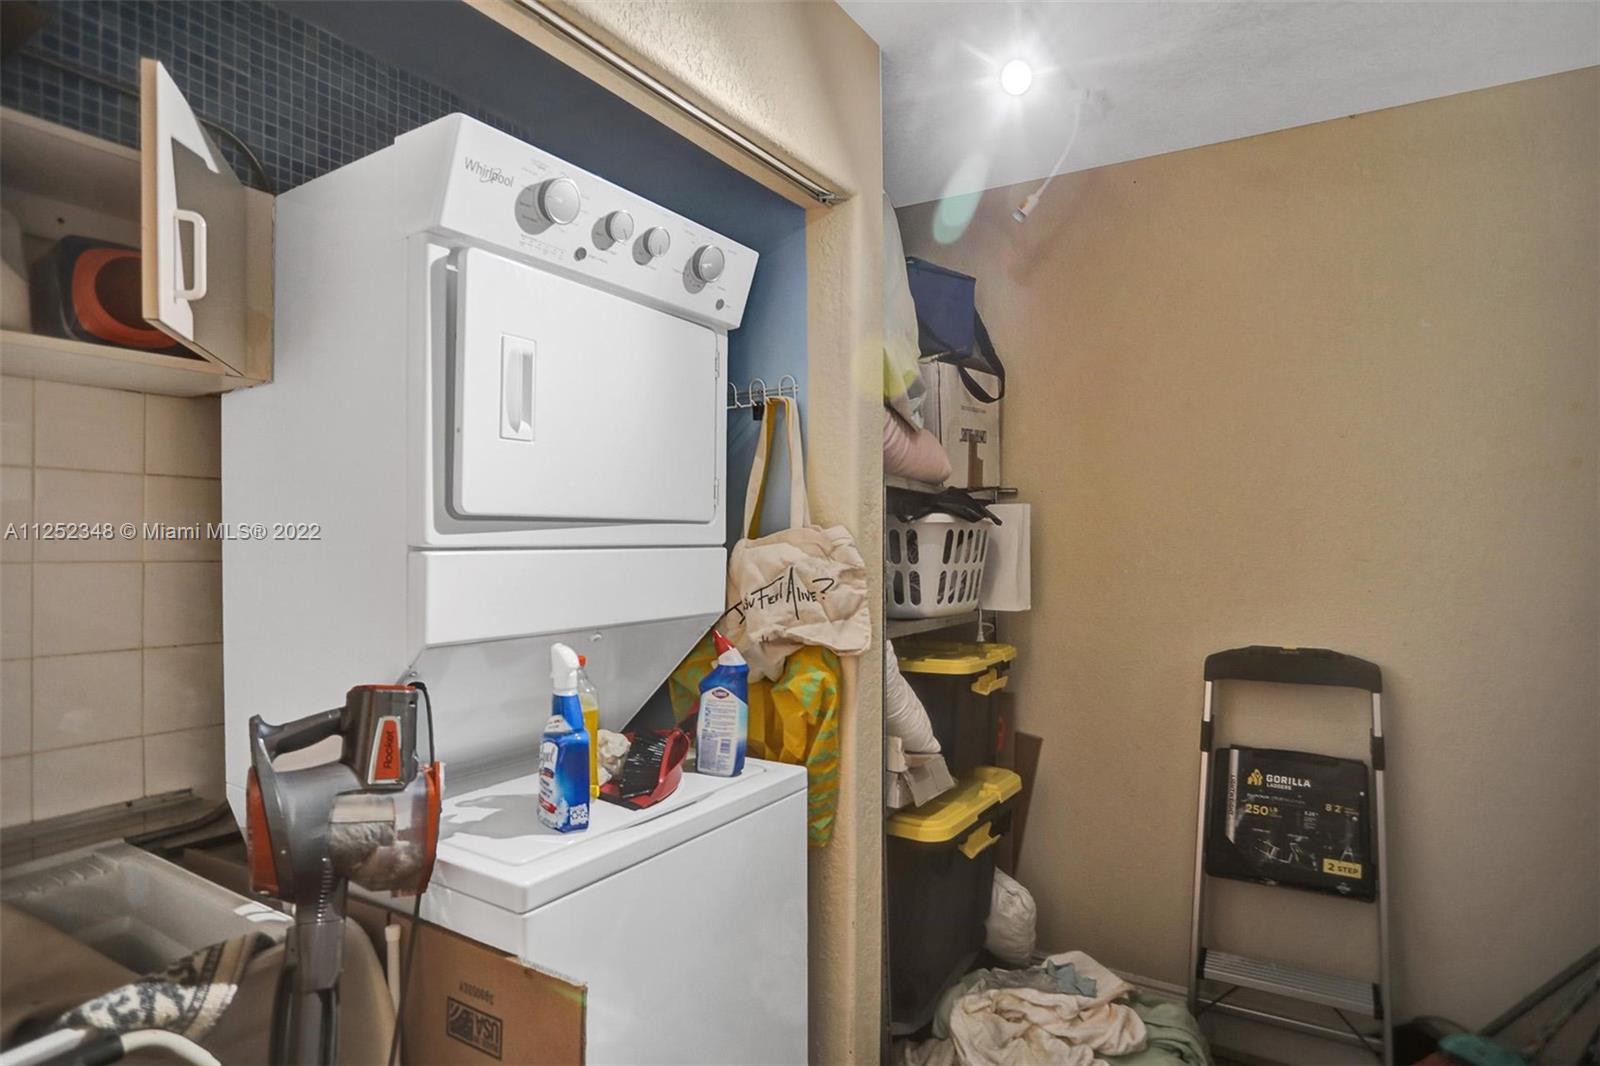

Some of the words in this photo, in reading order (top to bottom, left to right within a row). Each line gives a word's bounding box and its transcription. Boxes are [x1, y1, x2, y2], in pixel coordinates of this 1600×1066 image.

[464, 156, 514, 188] Whirlpool
[1265, 774, 1312, 788] GORILLA
[1245, 803, 1270, 816] 250
[1327, 862, 1336, 872] 2
[1336, 865, 1360, 876] STEP
